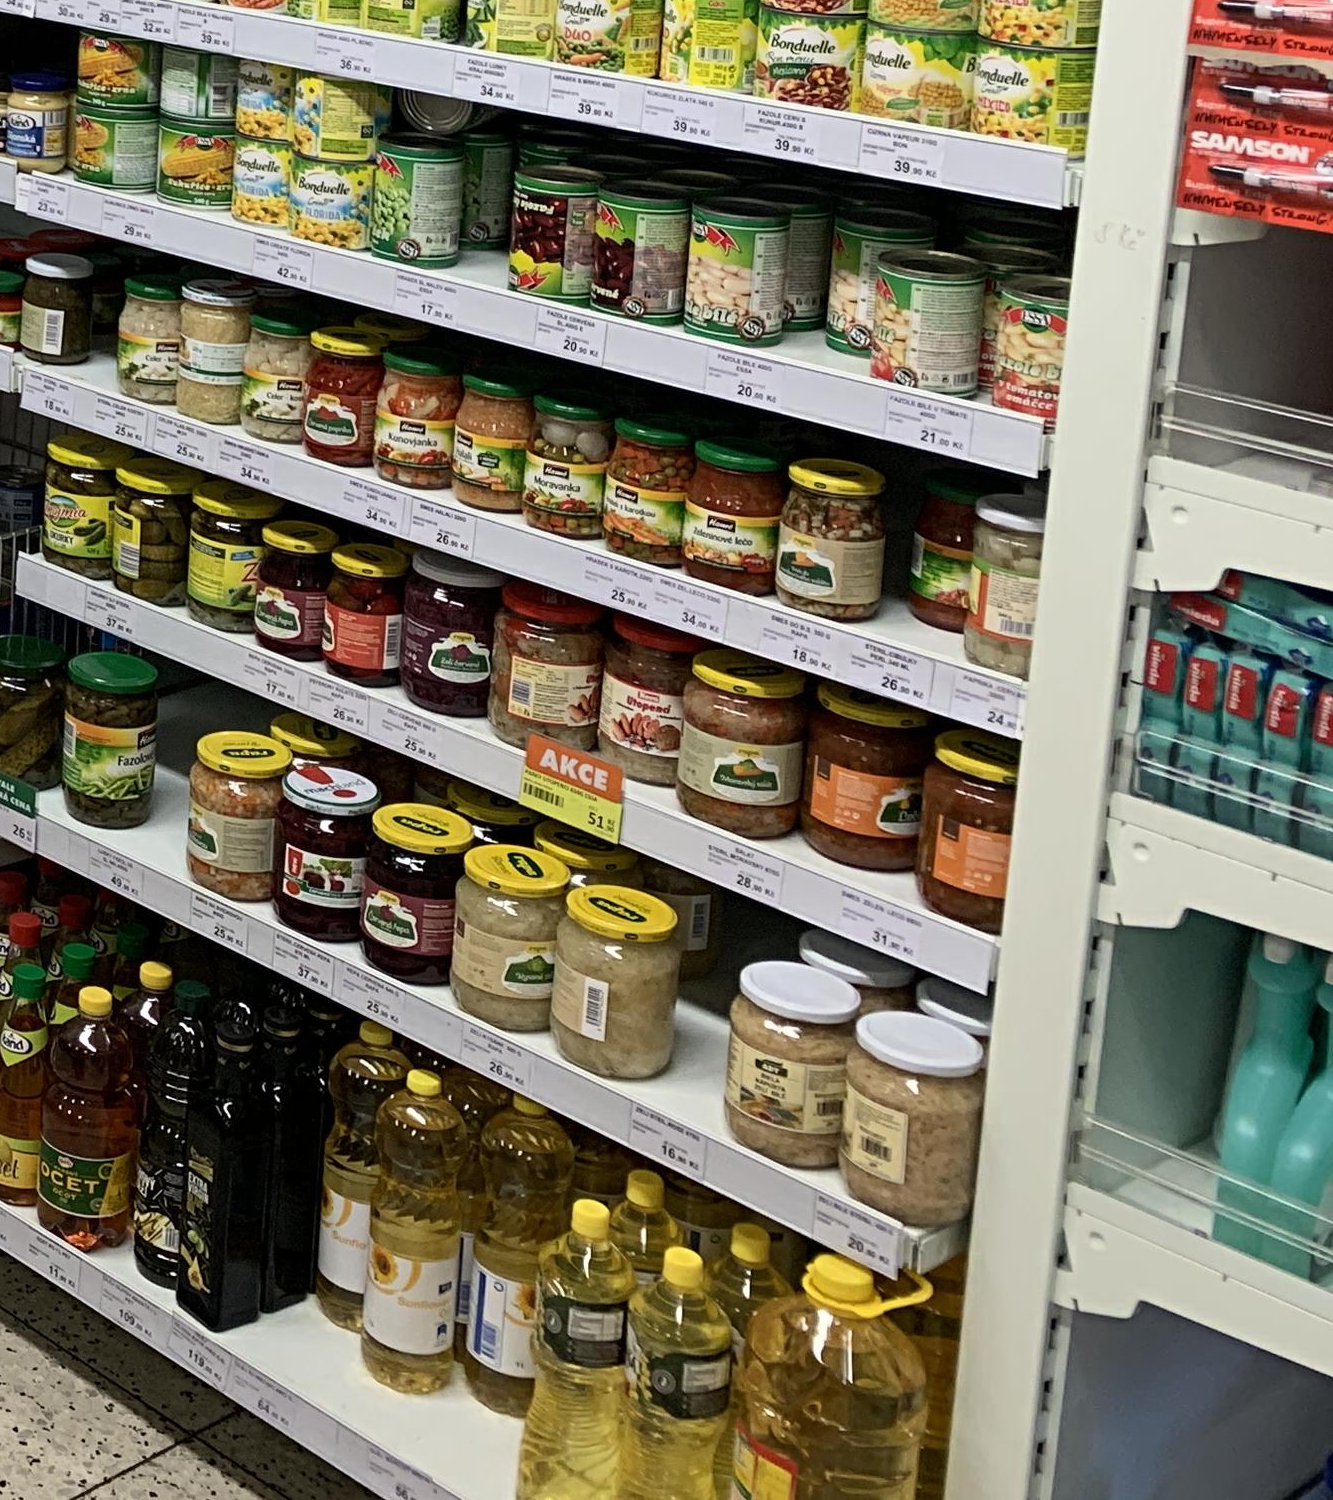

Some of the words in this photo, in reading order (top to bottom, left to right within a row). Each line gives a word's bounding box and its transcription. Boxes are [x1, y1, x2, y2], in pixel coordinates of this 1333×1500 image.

[564, 26, 592, 41] DUO
[771, 33, 836, 55] Bonduelle
[1192, 28, 1278, 49] IMMENSELY
[978, 96, 1011, 114] MEXICO
[1194, 112, 1278, 135] IMMENSELY
[1190, 130, 1310, 164] SAMSON
[299, 177, 351, 196] Bonduelle
[304, 206, 342, 220] FLORIDA
[387, 431, 439, 449] Kunovjanka
[533, 475, 581, 494] Moravanka
[1147, 645, 1162, 686] vileda
[1188, 662, 1202, 703] vileda
[1228, 668, 1242, 710] vileda
[1268, 689, 1286, 729] vileda
[539, 748, 610, 792] AKCE
[9, 794, 32, 814] CENA
[39, 1162, 100, 1195] OCET
